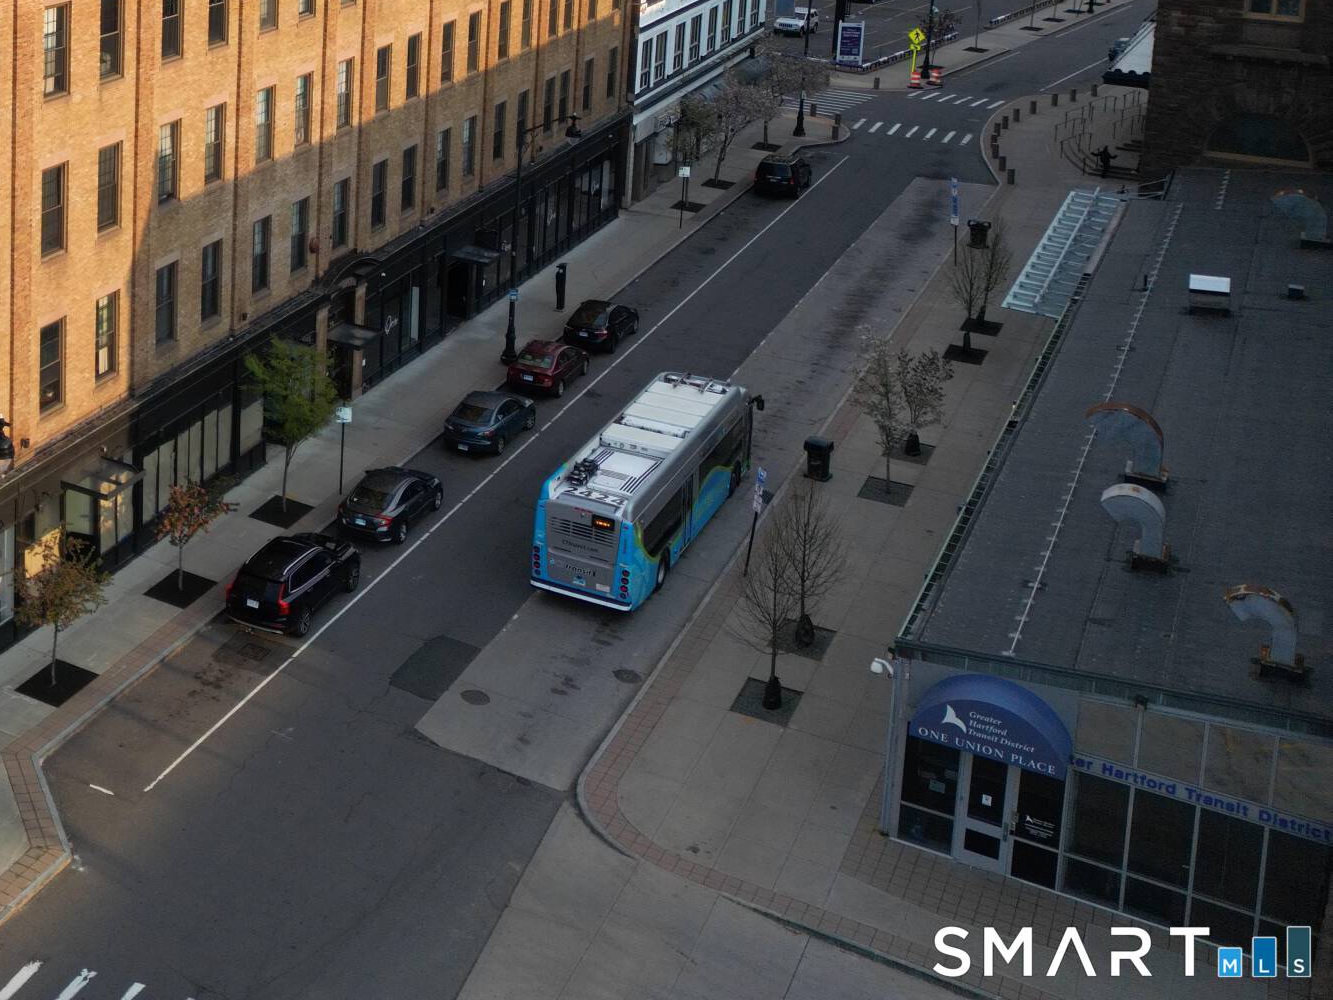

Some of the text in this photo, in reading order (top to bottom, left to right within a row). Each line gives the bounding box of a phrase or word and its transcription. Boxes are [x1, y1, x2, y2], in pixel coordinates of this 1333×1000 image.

[564, 487, 625, 505] 2424
[969, 711, 1002, 725] Greater
[969, 720, 1007, 737] Hartford
[918, 727, 948, 743] ONE
[955, 738, 1004, 759] UNION
[1011, 753, 1056, 775] PLACE
[968, 728, 1035, 753] Transit District
[1102, 763, 1176, 795] Hartford
[1185, 787, 1248, 817] Transit
[1258, 810, 1333, 842] District
